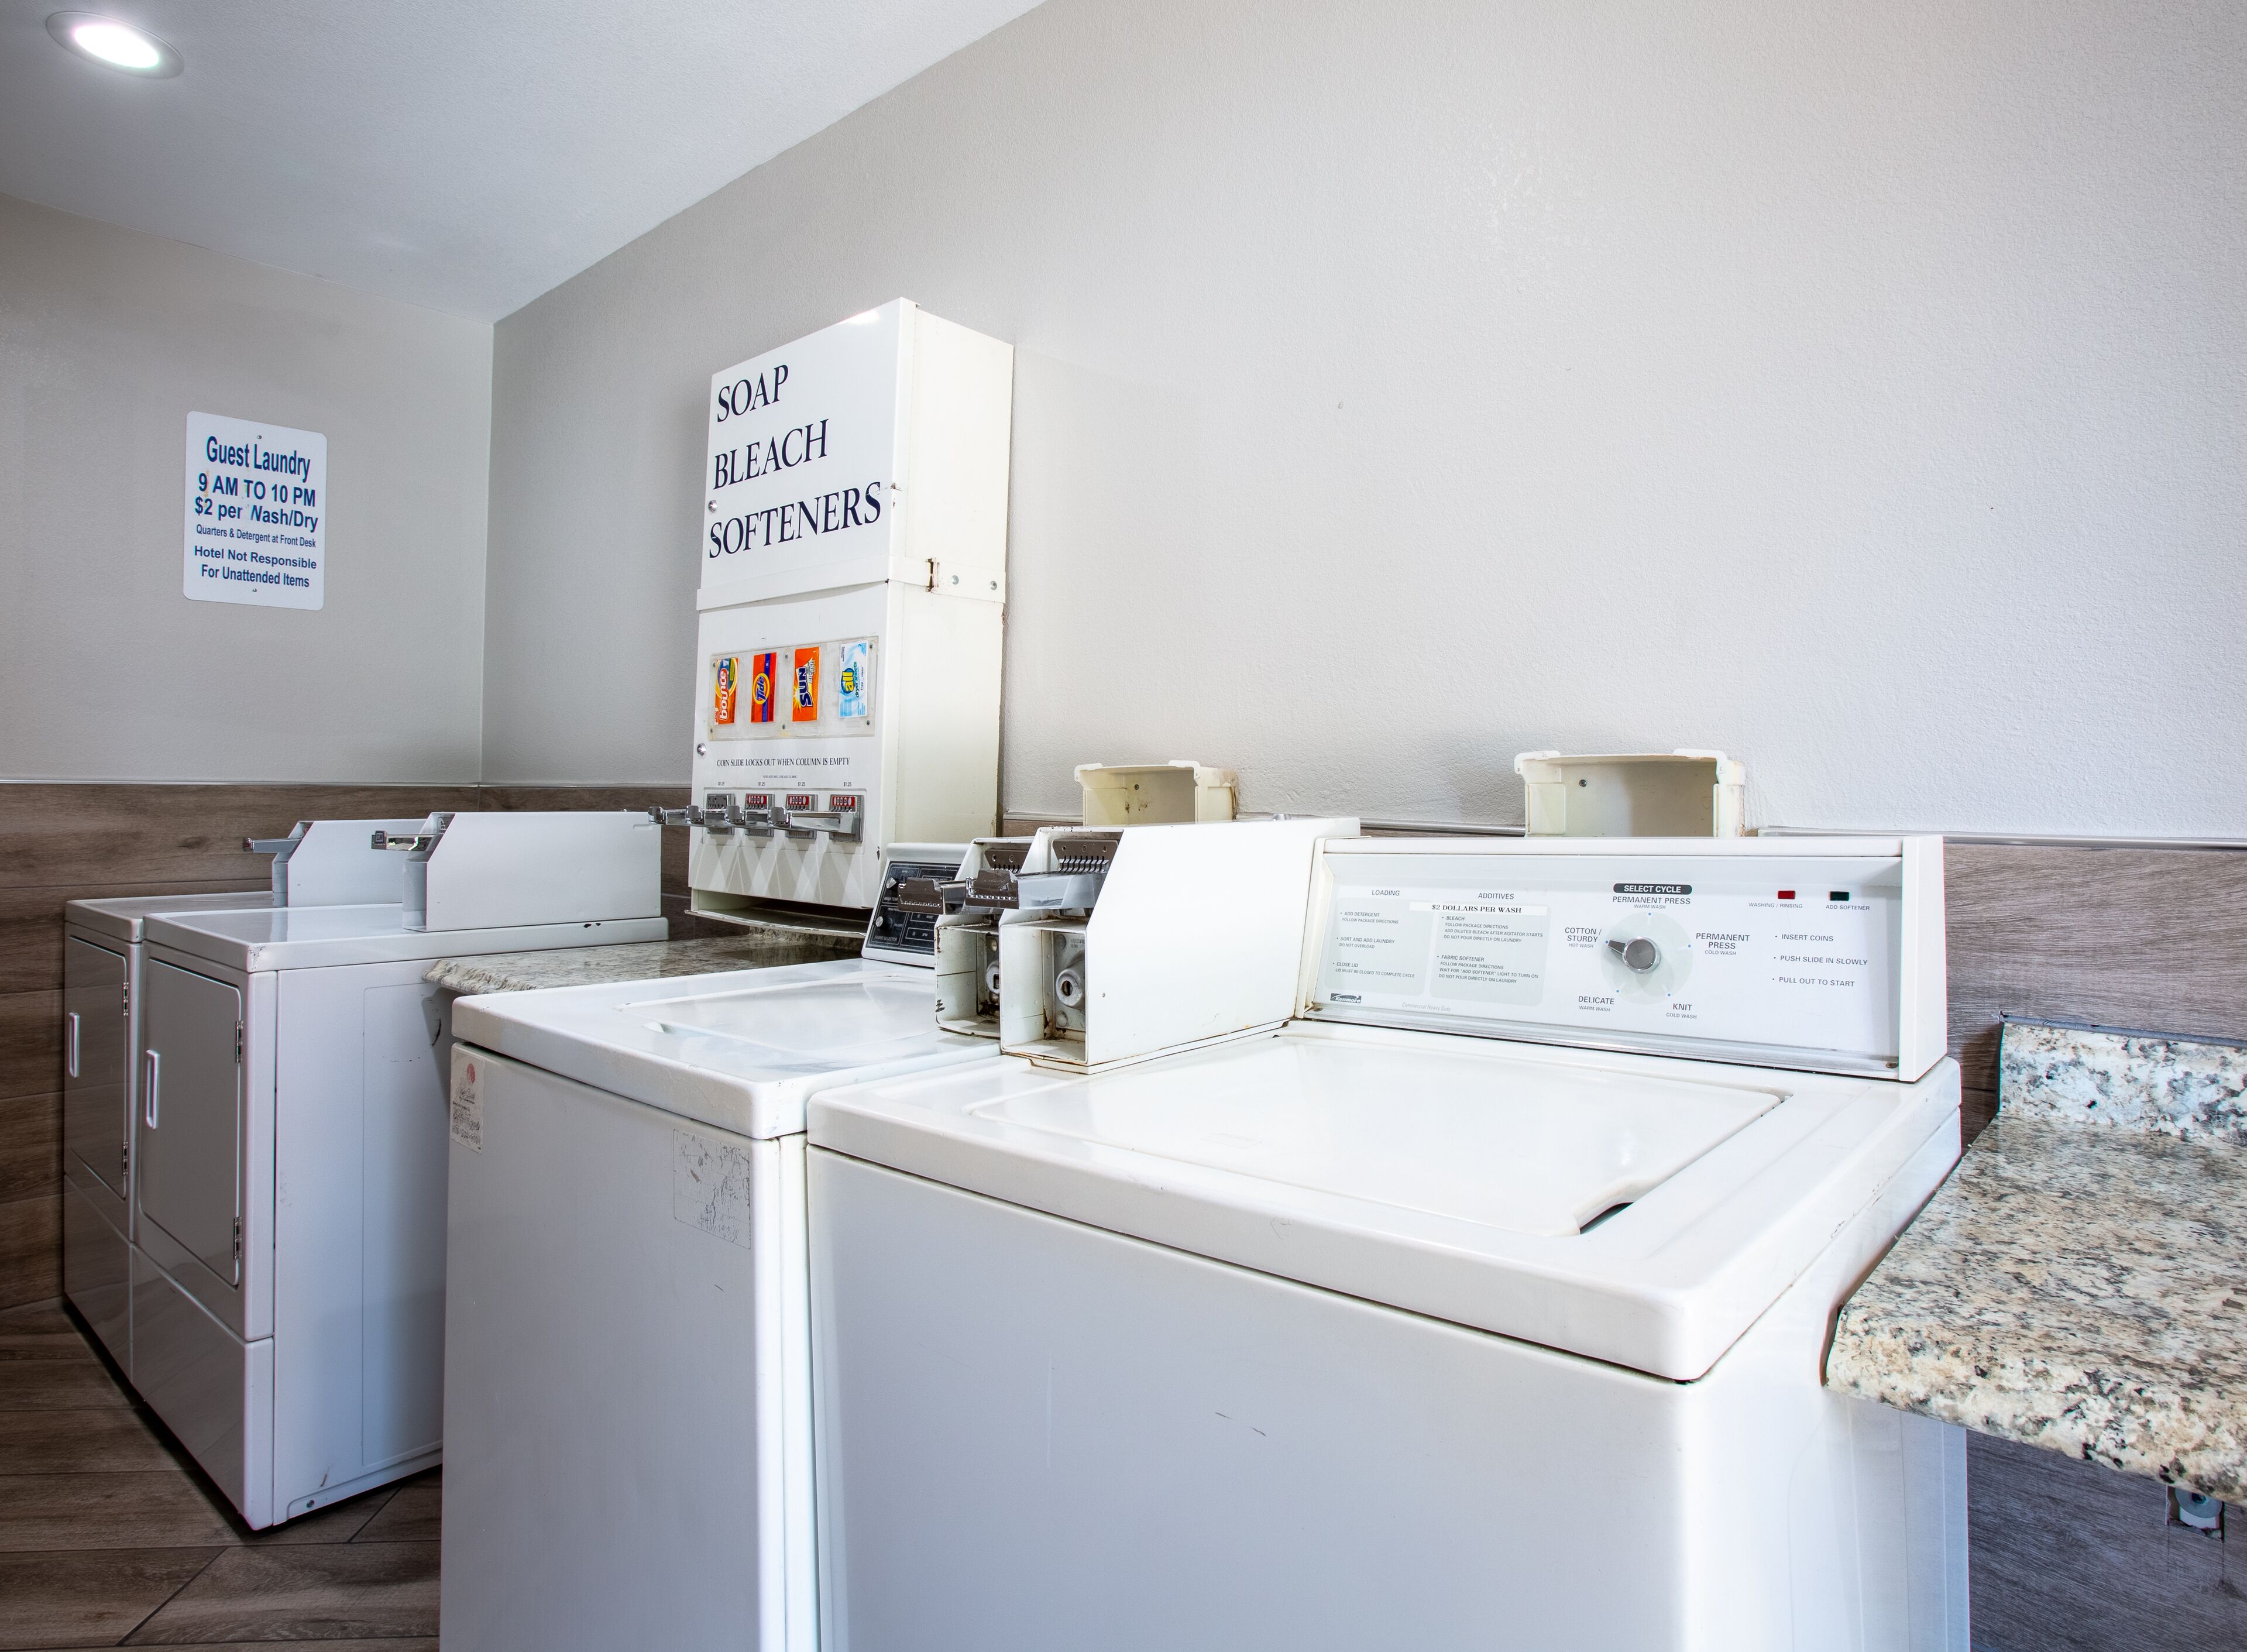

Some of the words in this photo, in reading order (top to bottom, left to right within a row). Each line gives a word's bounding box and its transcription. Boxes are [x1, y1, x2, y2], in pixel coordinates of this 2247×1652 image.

[717, 365, 789, 422] SOAP
[207, 436, 249, 468] Guest
[255, 444, 311, 483] Laundry
[713, 419, 829, 490] BLEACH
[198, 473, 207, 491] 9
[212, 475, 238, 496] AM
[244, 479, 266, 499] TO
[272, 484, 288, 503] 10
[293, 487, 315, 507] PM
[195, 496, 212, 516] $2
[218, 504, 242, 520] per
[709, 482, 881, 558] SOFTENERS
[197, 524, 227, 537] Quarters
[230, 528, 234, 538] &
[237, 530, 270, 543] Detergent
[280, 535, 298, 545] Front
[300, 537, 315, 548] Desk
[194, 545, 224, 558] Hotel
[228, 549, 247, 561] Not
[251, 552, 317, 569] Responsible
[201, 564, 219, 578] For
[223, 566, 280, 584] Unattended
[284, 573, 310, 587] Items
[756, 676, 767, 701] Tide
[798, 667, 813, 707] SUN
[842, 672, 854, 692] all
[720, 671, 728, 719] bounce
[830, 757, 850, 765] EMPTY
[1567, 935, 1597, 943] STURDY
[1597, 928, 1602, 936] /
[1696, 933, 1750, 942] PERMANENT
[1708, 941, 1736, 949] PRESS
[1780, 955, 1800, 963] PUSH
[1802, 956, 1823, 964] SLIDE
[1799, 977, 1815, 985] OUT
[1578, 996, 1615, 1005] DELICATE
[1672, 1003, 1692, 1011] KNIT
